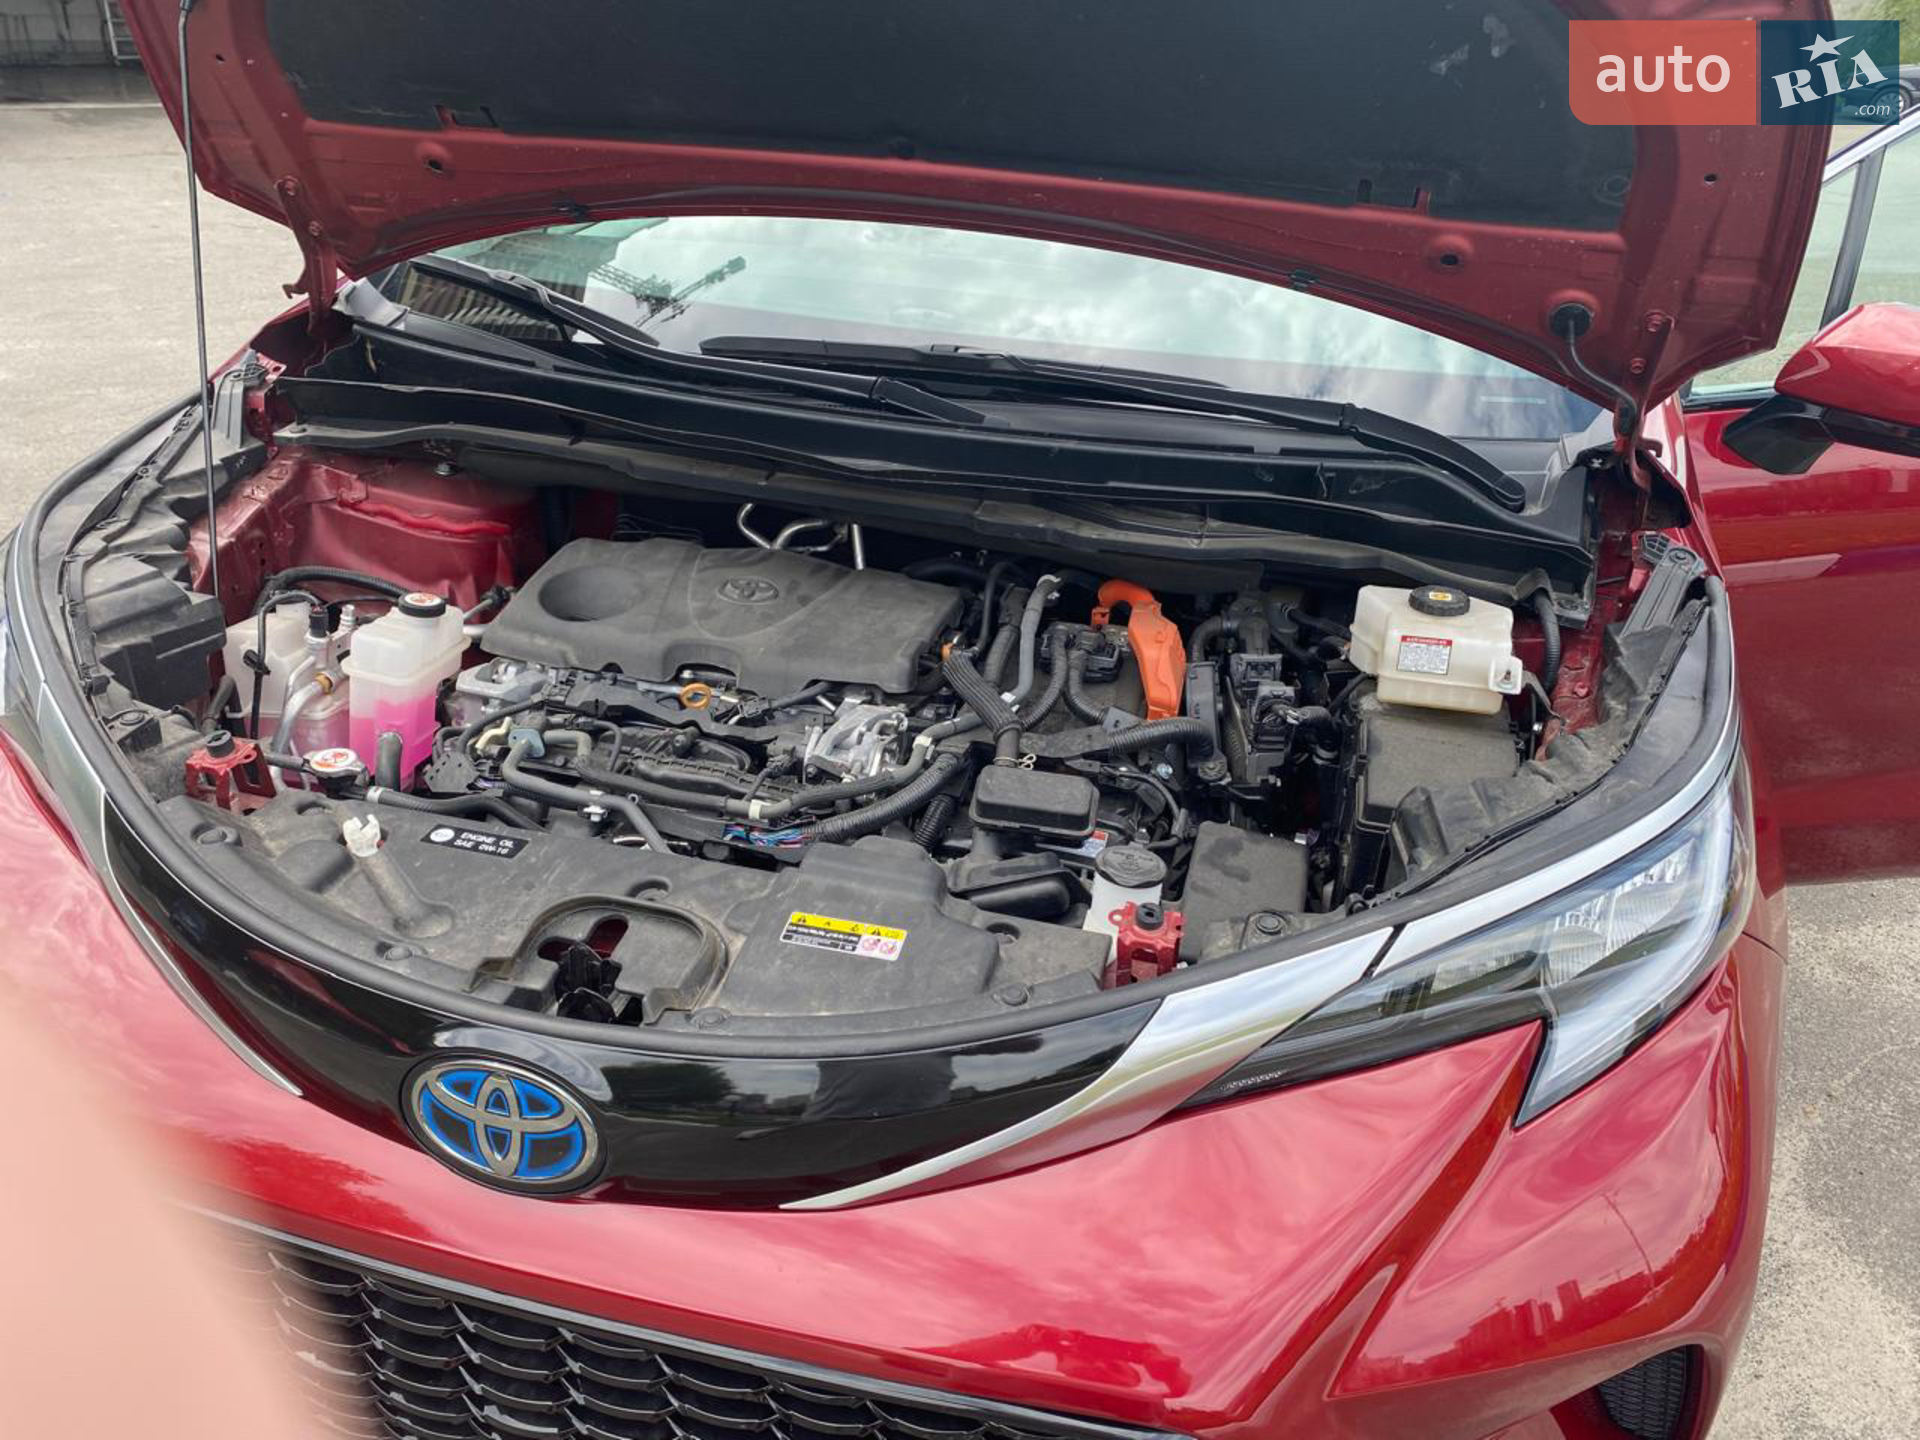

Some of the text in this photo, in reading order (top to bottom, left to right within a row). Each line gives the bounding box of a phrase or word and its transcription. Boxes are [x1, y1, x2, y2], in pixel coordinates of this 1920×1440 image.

[454, 839, 475, 848] SAE
[460, 832, 514, 848] ENGINE OIL
